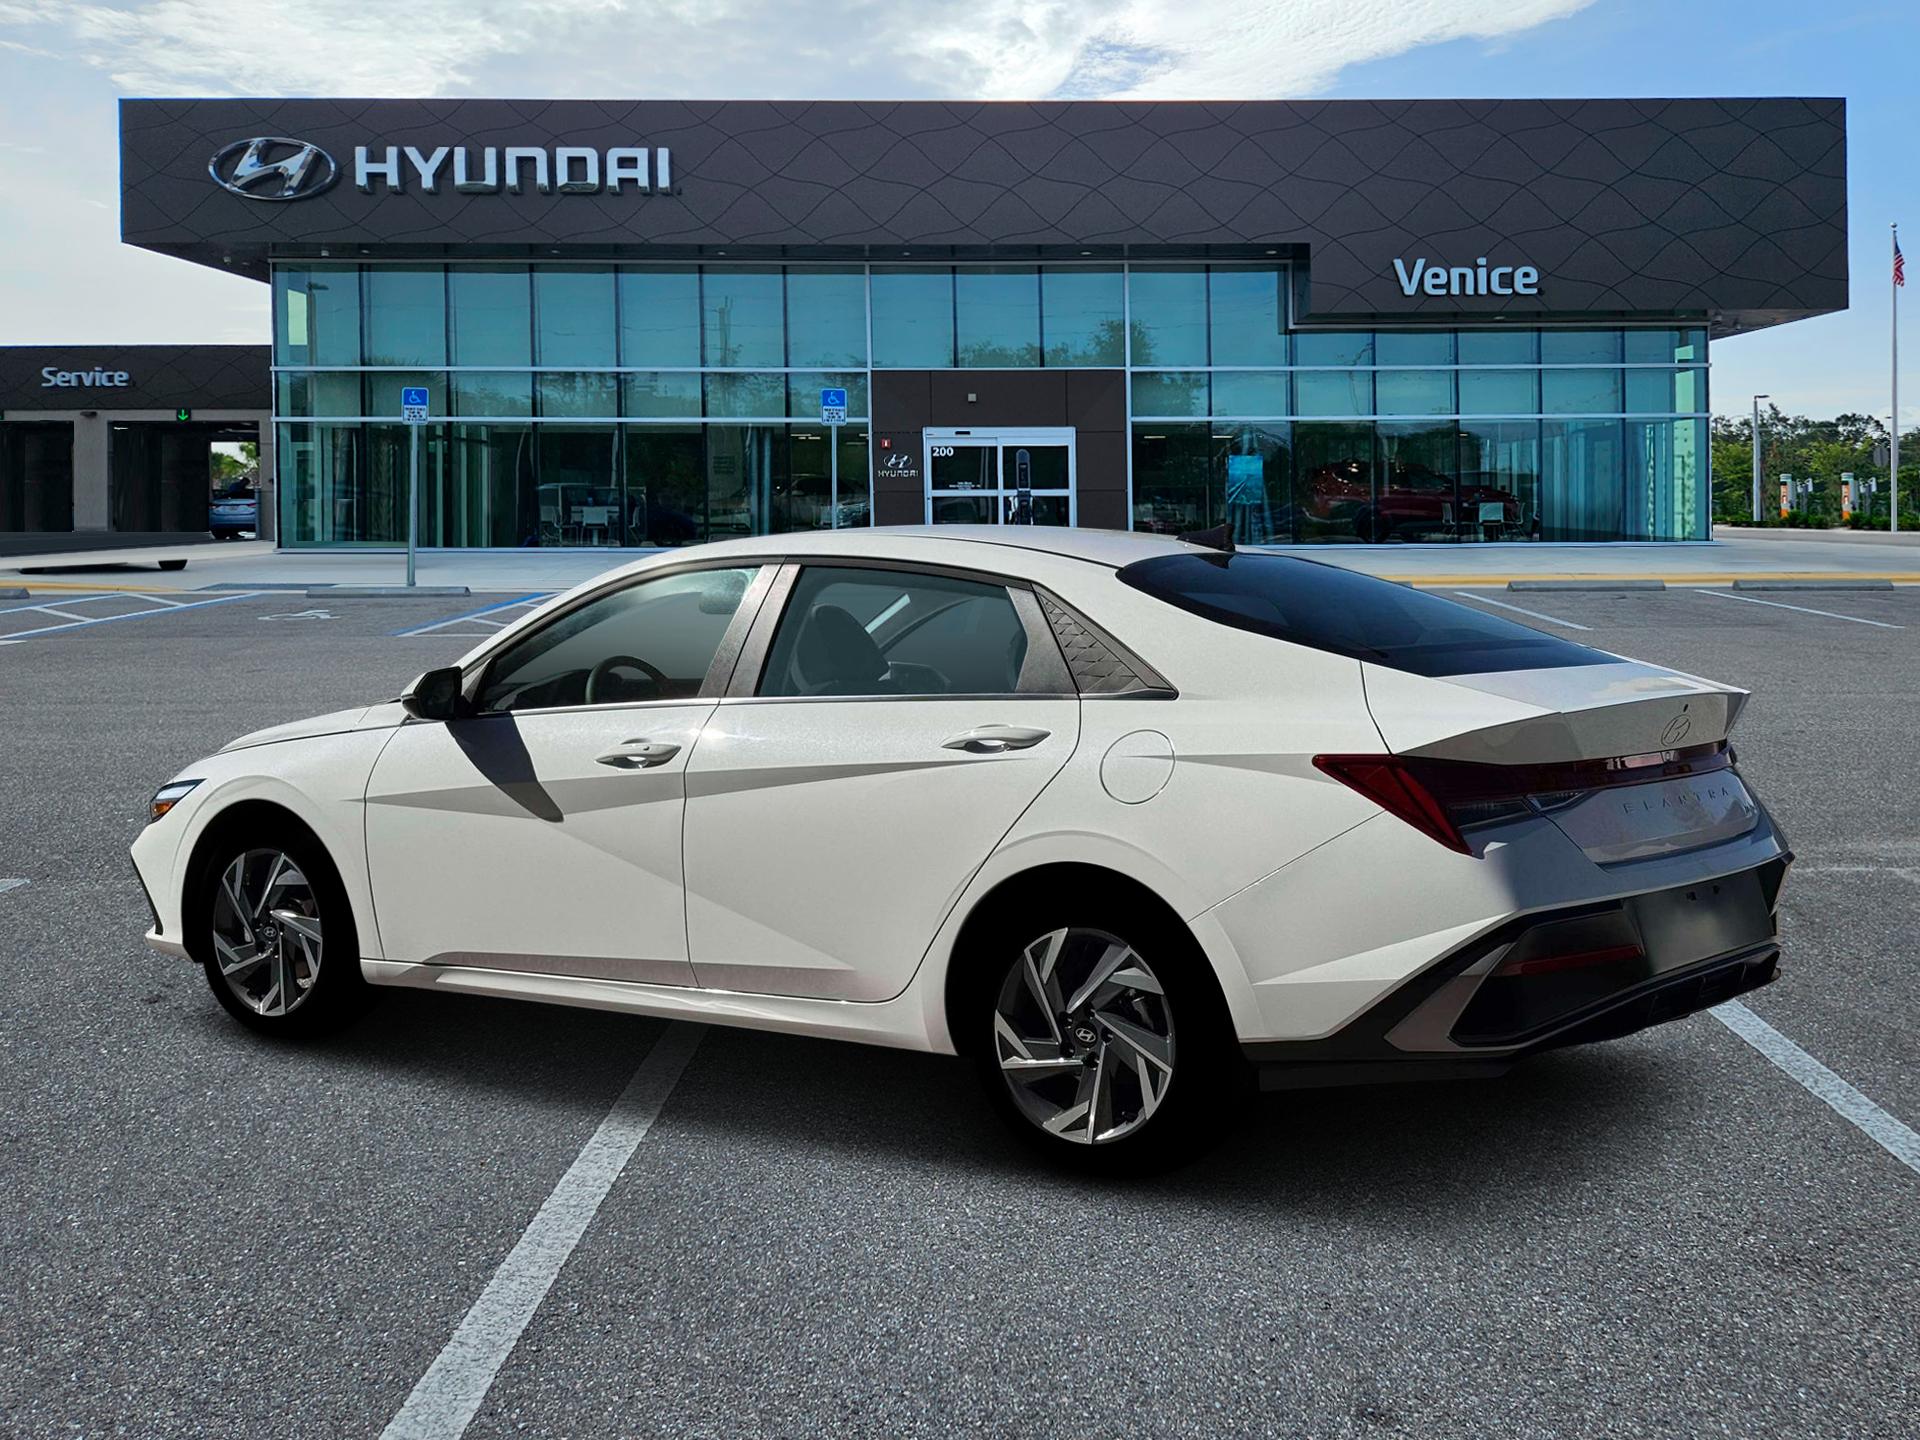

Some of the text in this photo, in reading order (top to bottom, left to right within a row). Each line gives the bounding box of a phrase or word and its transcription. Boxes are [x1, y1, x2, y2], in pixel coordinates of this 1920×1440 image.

[353, 145, 671, 195] HYUNDAI
[1392, 256, 1539, 296] Venice
[41, 366, 129, 387] Service
[932, 447, 955, 457] 200
